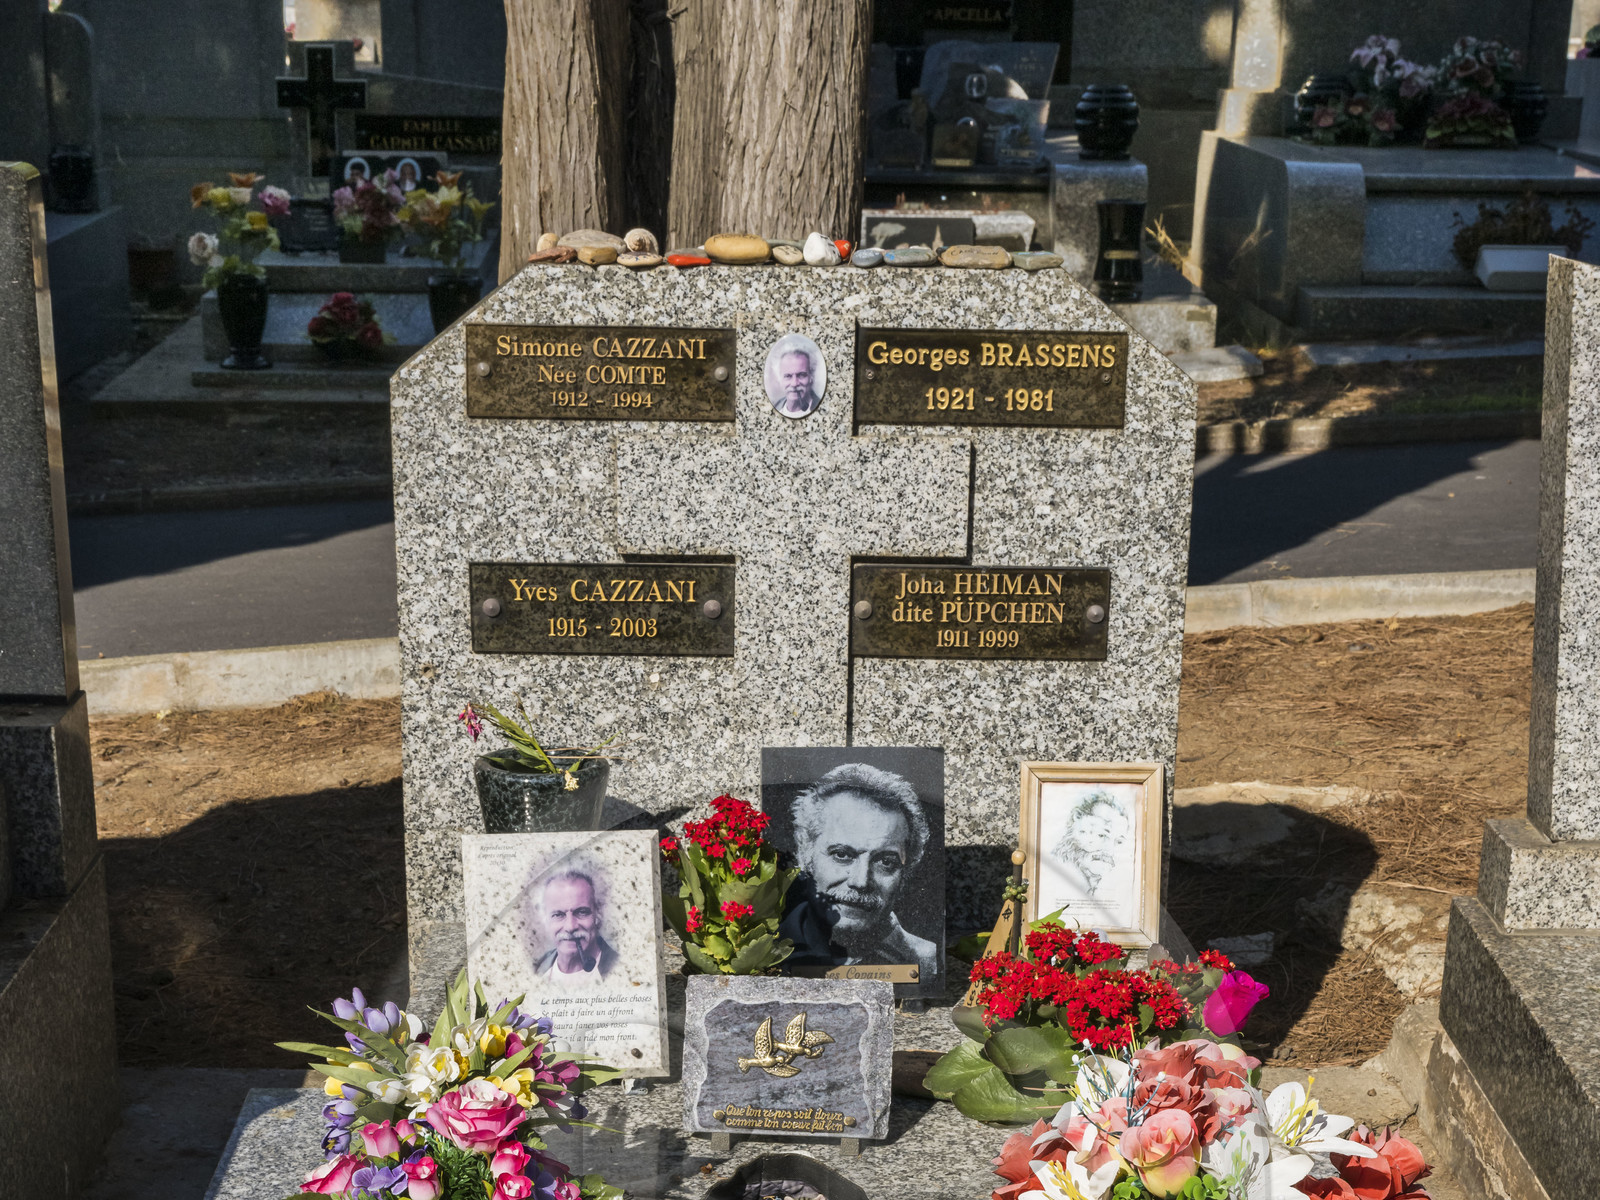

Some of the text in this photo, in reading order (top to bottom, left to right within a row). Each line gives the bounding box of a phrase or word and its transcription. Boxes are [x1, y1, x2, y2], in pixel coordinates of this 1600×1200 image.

[496, 335, 707, 360] Simone CAZZANI
[867, 341, 1117, 372] Georges BRASSENS
[586, 364, 667, 386] COMTE
[550, 391, 589, 408] 1912
[612, 392, 653, 408] 1994
[925, 387, 975, 411] 1921
[1004, 388, 1054, 412] 1981
[508, 578, 697, 603] Yves CAZZANI
[894, 573, 1064, 600] Joha HEIMAN
[892, 596, 1066, 624] dite PÜPCHEN
[547, 617, 588, 638] 1915
[610, 617, 658, 638] 2003
[846, 966, 892, 981] Copains
[540, 993, 653, 1008] Le temps aux plus belles choses
[541, 1009, 550, 1018] Se
[577, 1008, 594, 1020] faire
[596, 1009, 606, 1017] un
[607, 1007, 634, 1019] affront
[575, 1020, 595, 1032] faner
[596, 1021, 609, 1029] vos
[610, 1021, 629, 1029] roses
[726, 1104, 843, 1121] Que ton repos soit doux
[725, 1117, 763, 1127] comme
[763, 1117, 780, 1129] ton
[825, 1120, 843, 1132] bon
